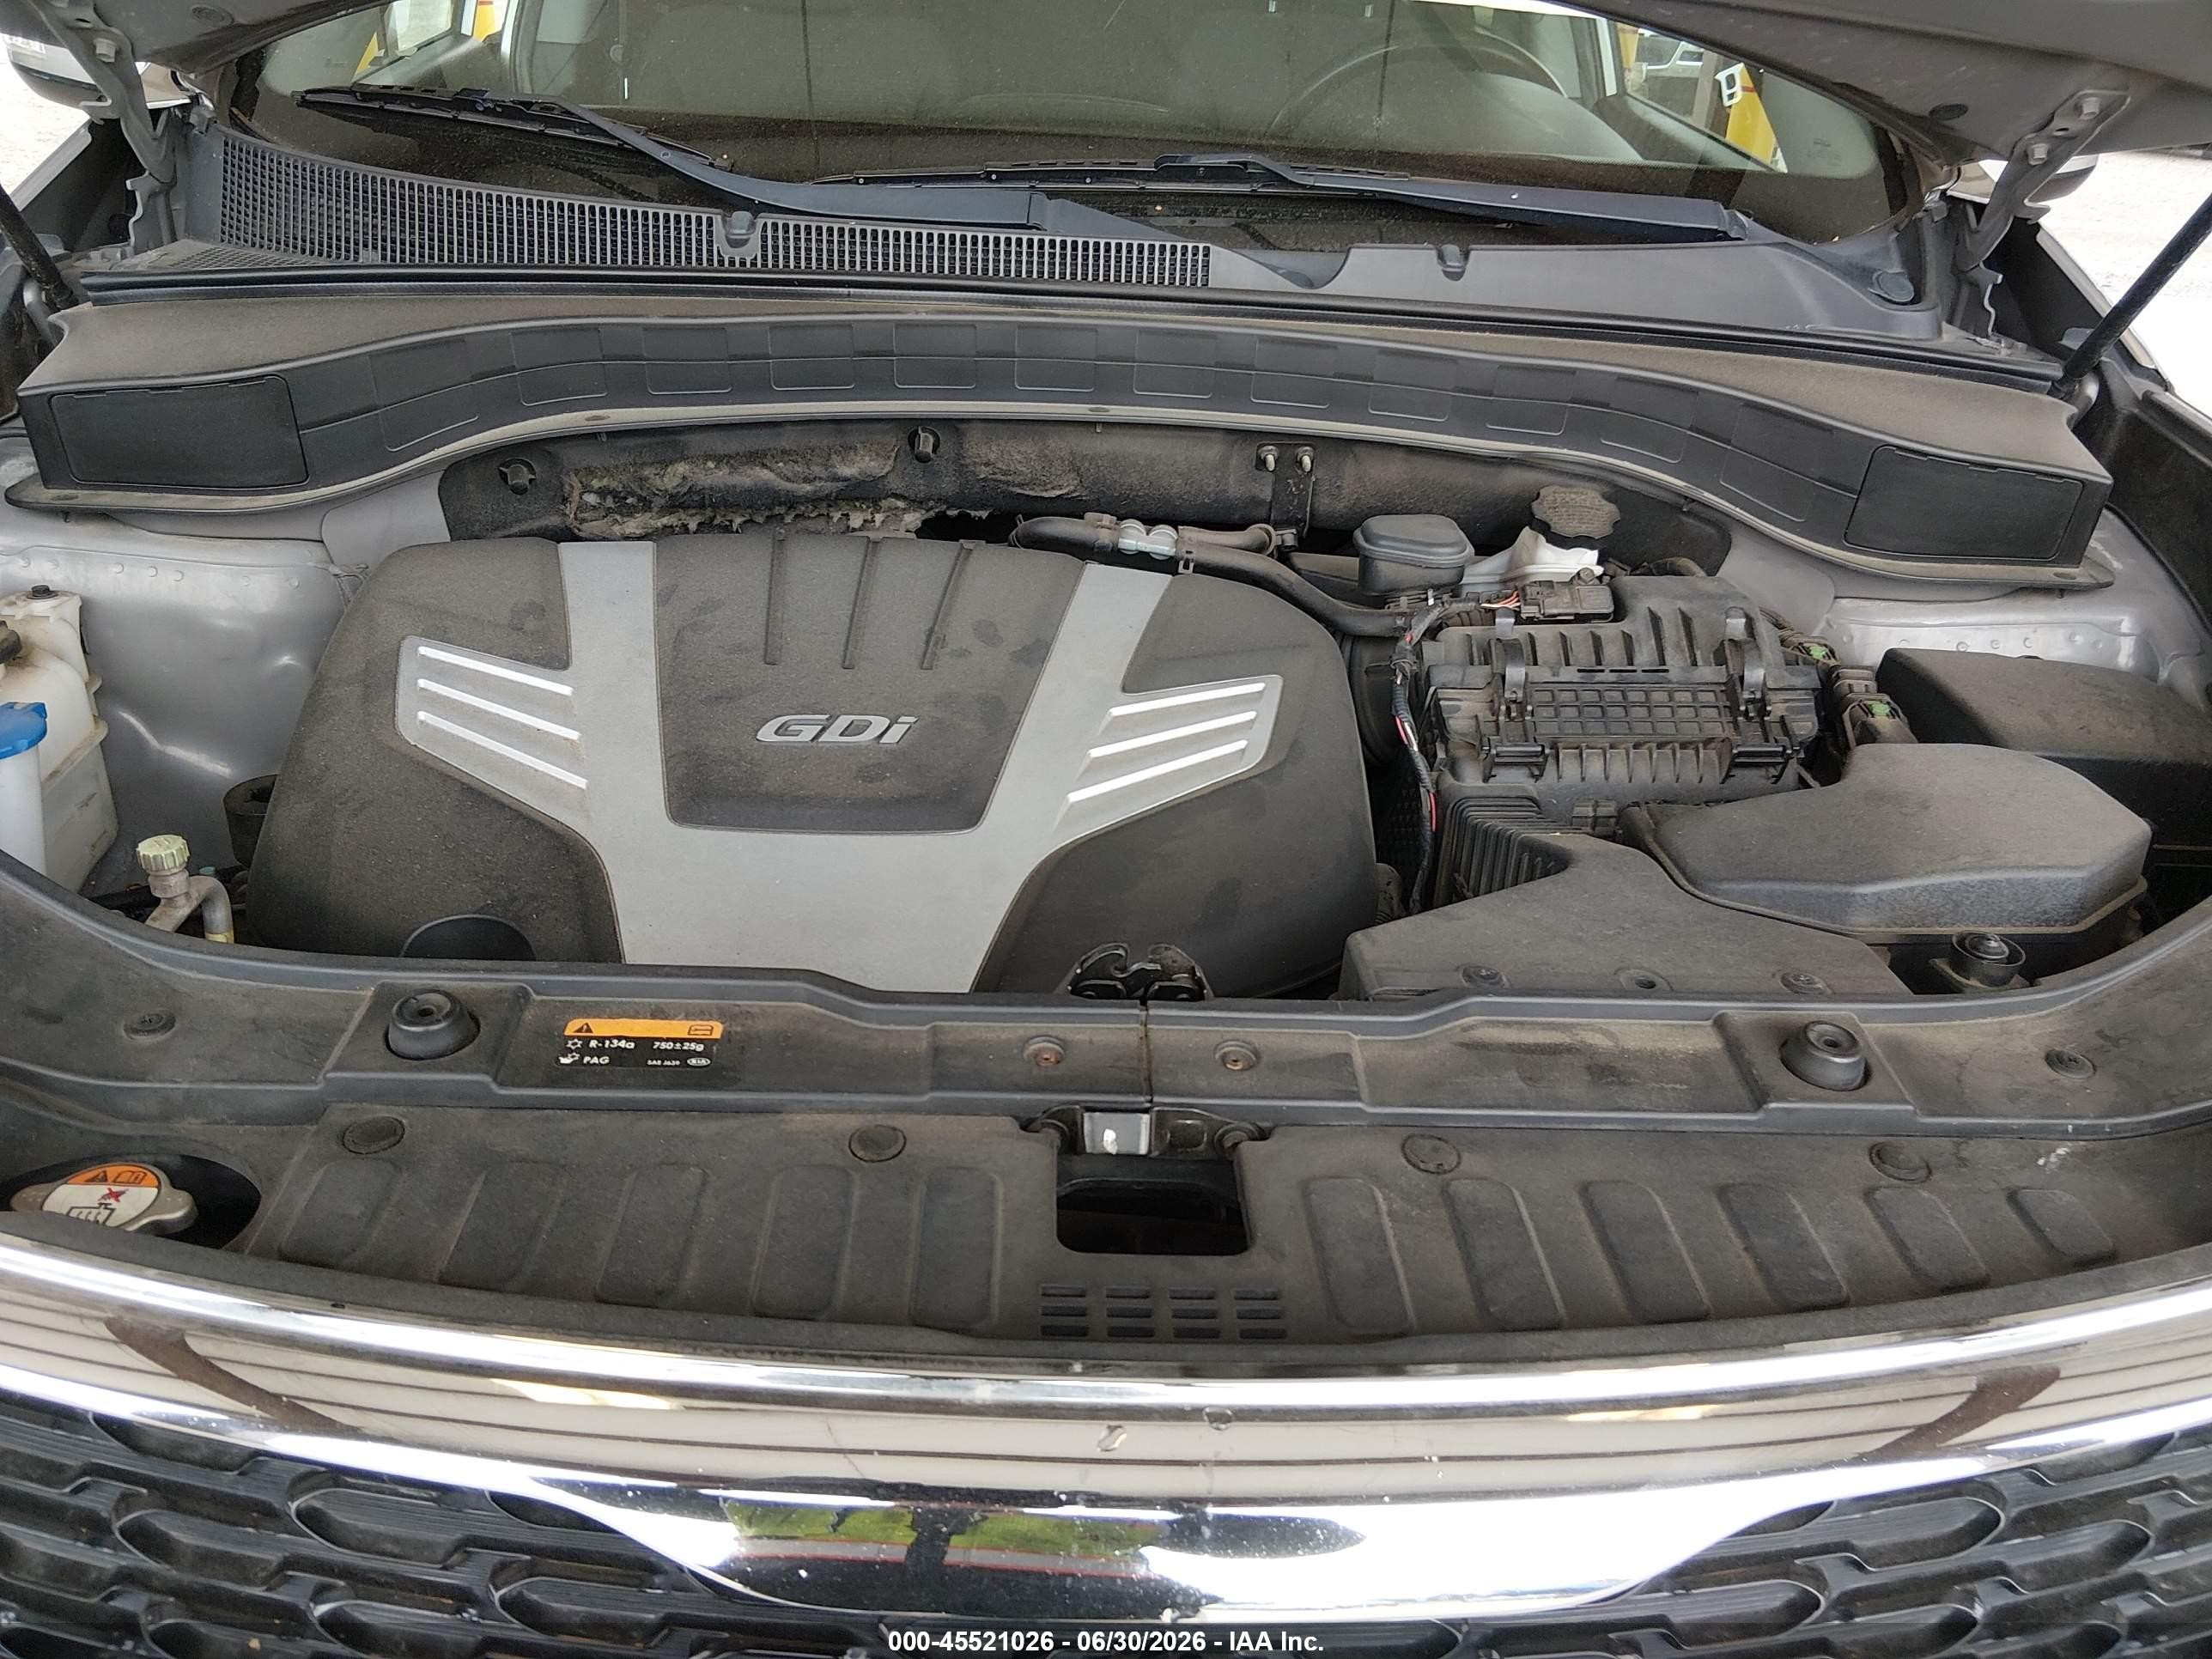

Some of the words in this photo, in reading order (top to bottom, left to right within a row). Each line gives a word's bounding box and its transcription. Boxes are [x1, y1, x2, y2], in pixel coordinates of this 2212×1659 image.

[756, 714, 919, 744] GDi
[589, 1039, 635, 1049] R-134a
[653, 1041, 705, 1052] 750±25g
[583, 1055, 610, 1065] PAG
